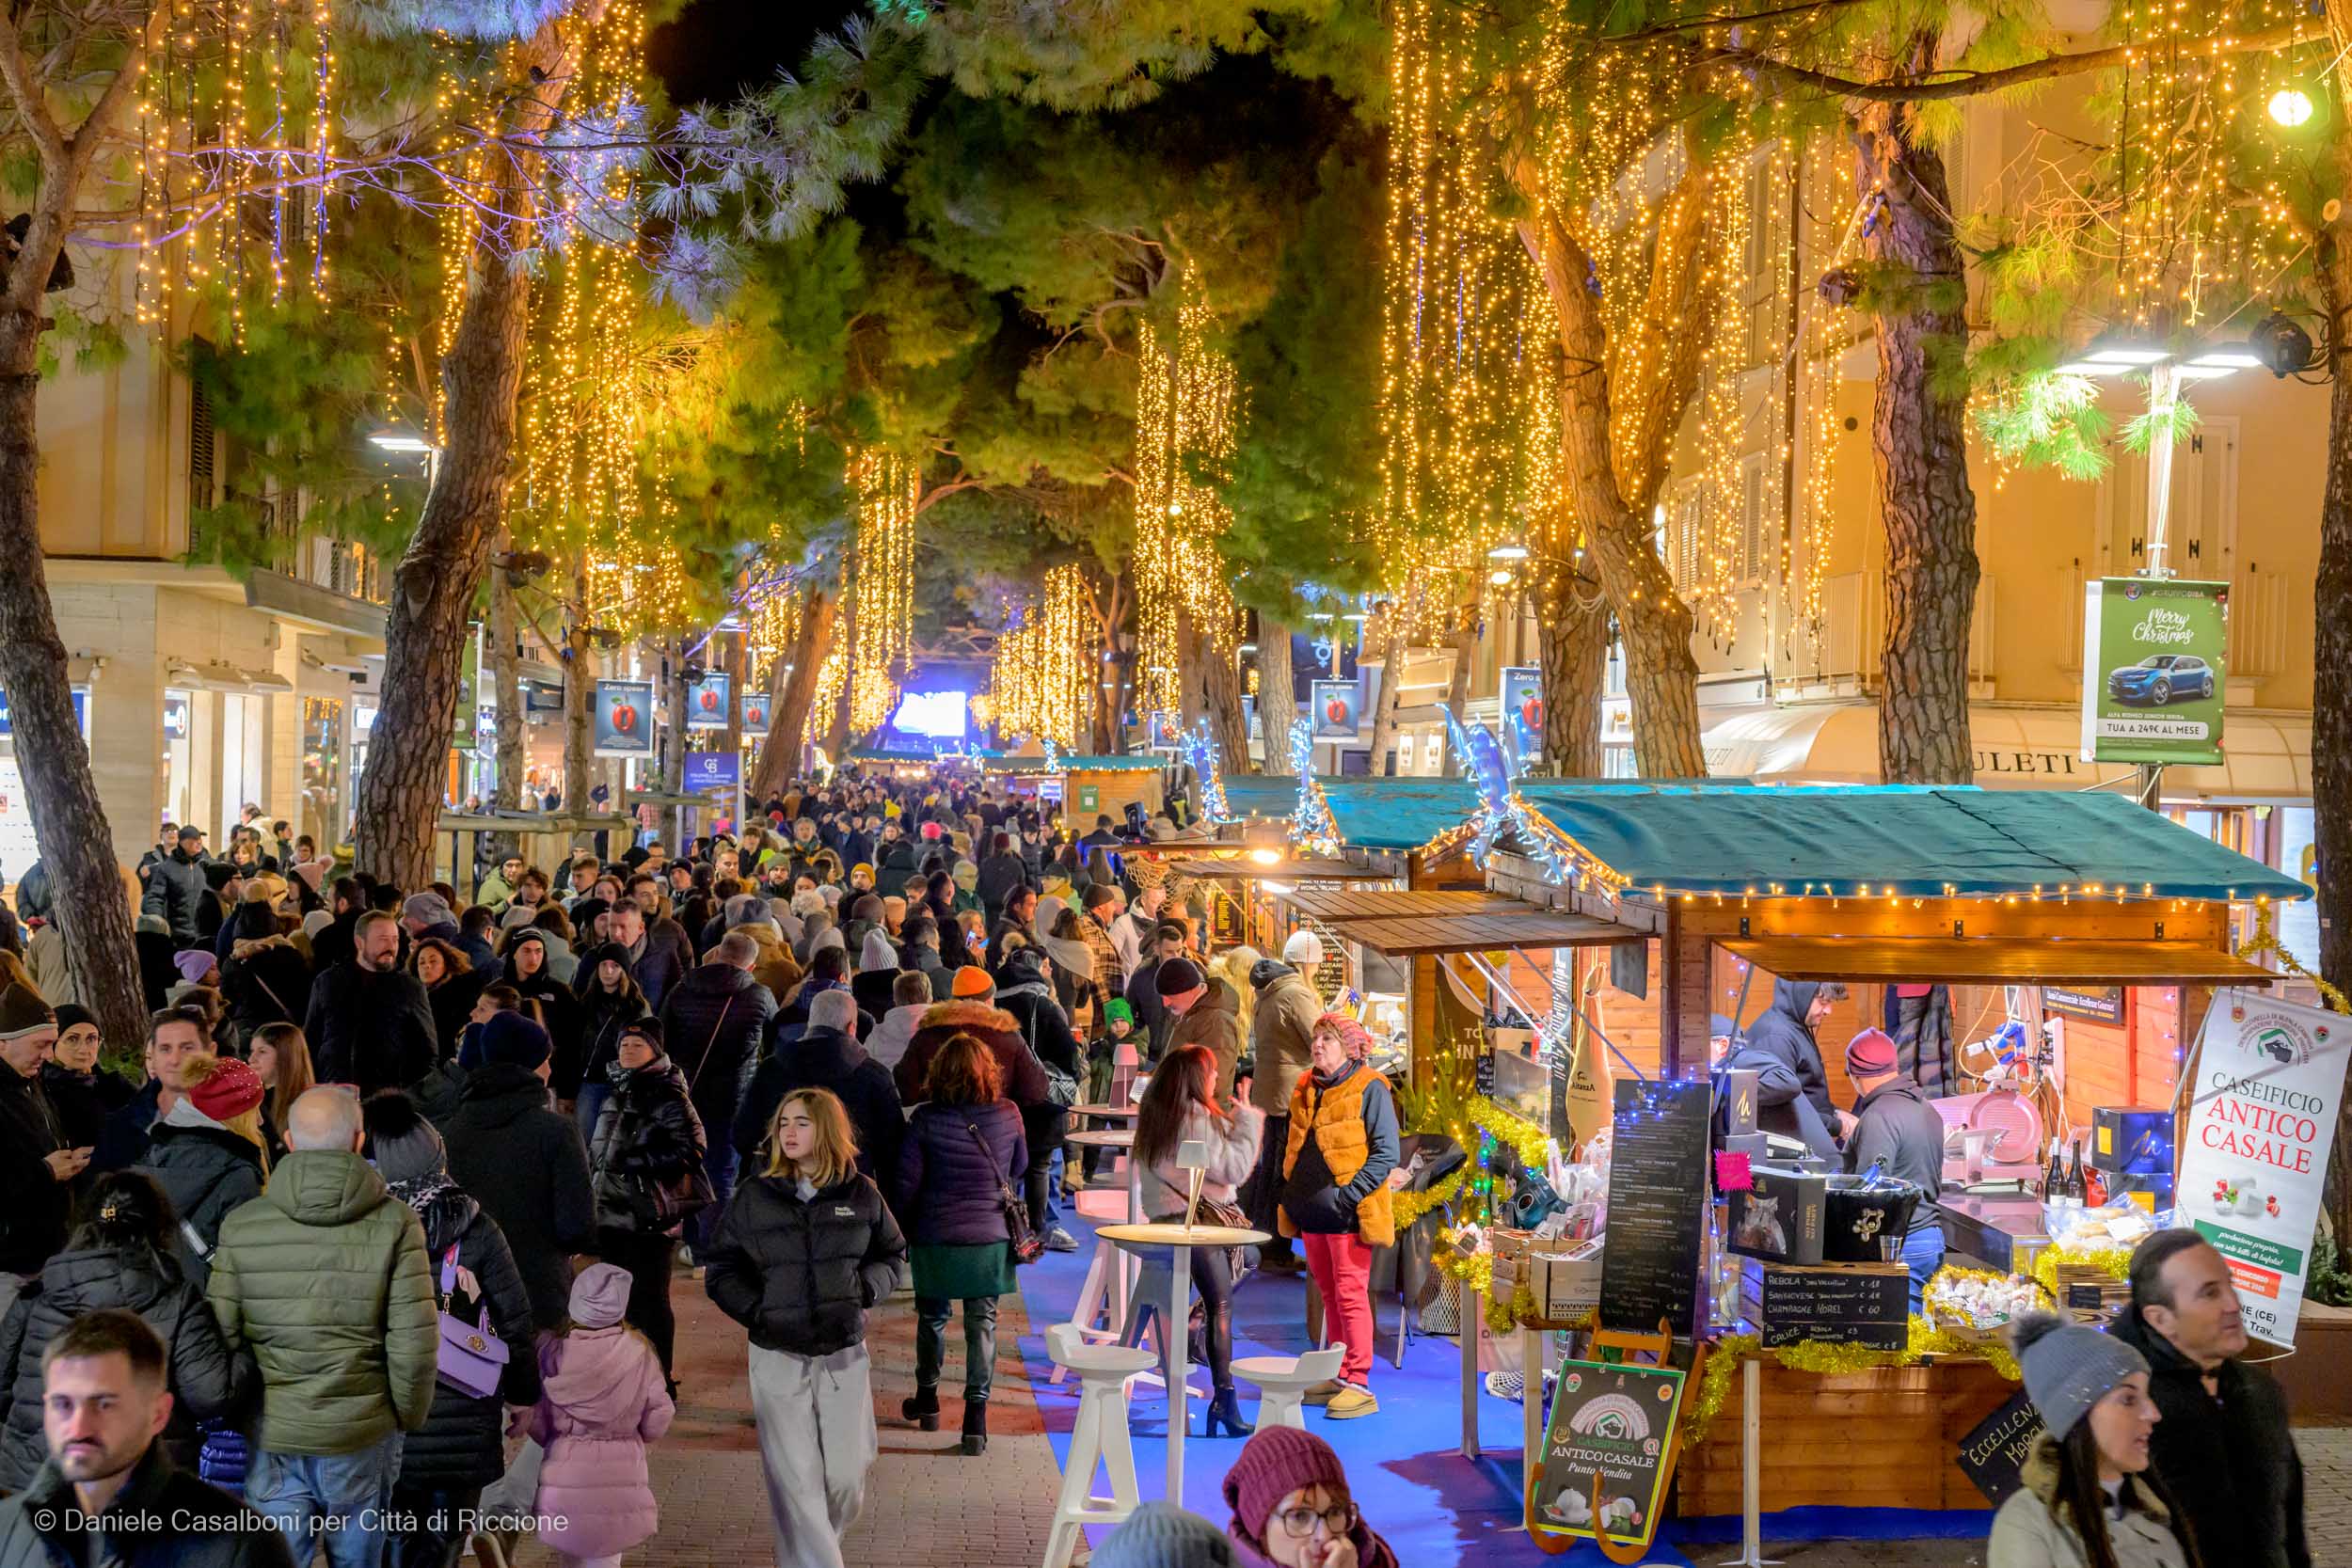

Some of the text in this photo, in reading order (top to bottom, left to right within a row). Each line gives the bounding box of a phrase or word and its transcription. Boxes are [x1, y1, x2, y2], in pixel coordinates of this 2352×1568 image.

[2148, 608, 2190, 631] Merry
[2132, 622, 2194, 645] Christmas
[1514, 672, 1534, 682] Zero
[2107, 723, 2125, 732] TUA
[2128, 724, 2136, 733] A
[2162, 725, 2173, 735] AL
[2176, 725, 2200, 735] MESE
[2212, 1071, 2324, 1115] CASEIFICIO
[2206, 1095, 2317, 1144] ANTICO
[2201, 1124, 2312, 1174] CASALE
[1768, 1275, 1801, 1286] REBOLA
[2254, 1307, 2277, 1324] (CE)
[2249, 1320, 2274, 1337] Trav.
[1551, 1446, 1655, 1468] ANTICO CASALE
[1567, 1462, 1632, 1481] Punto Vendita
